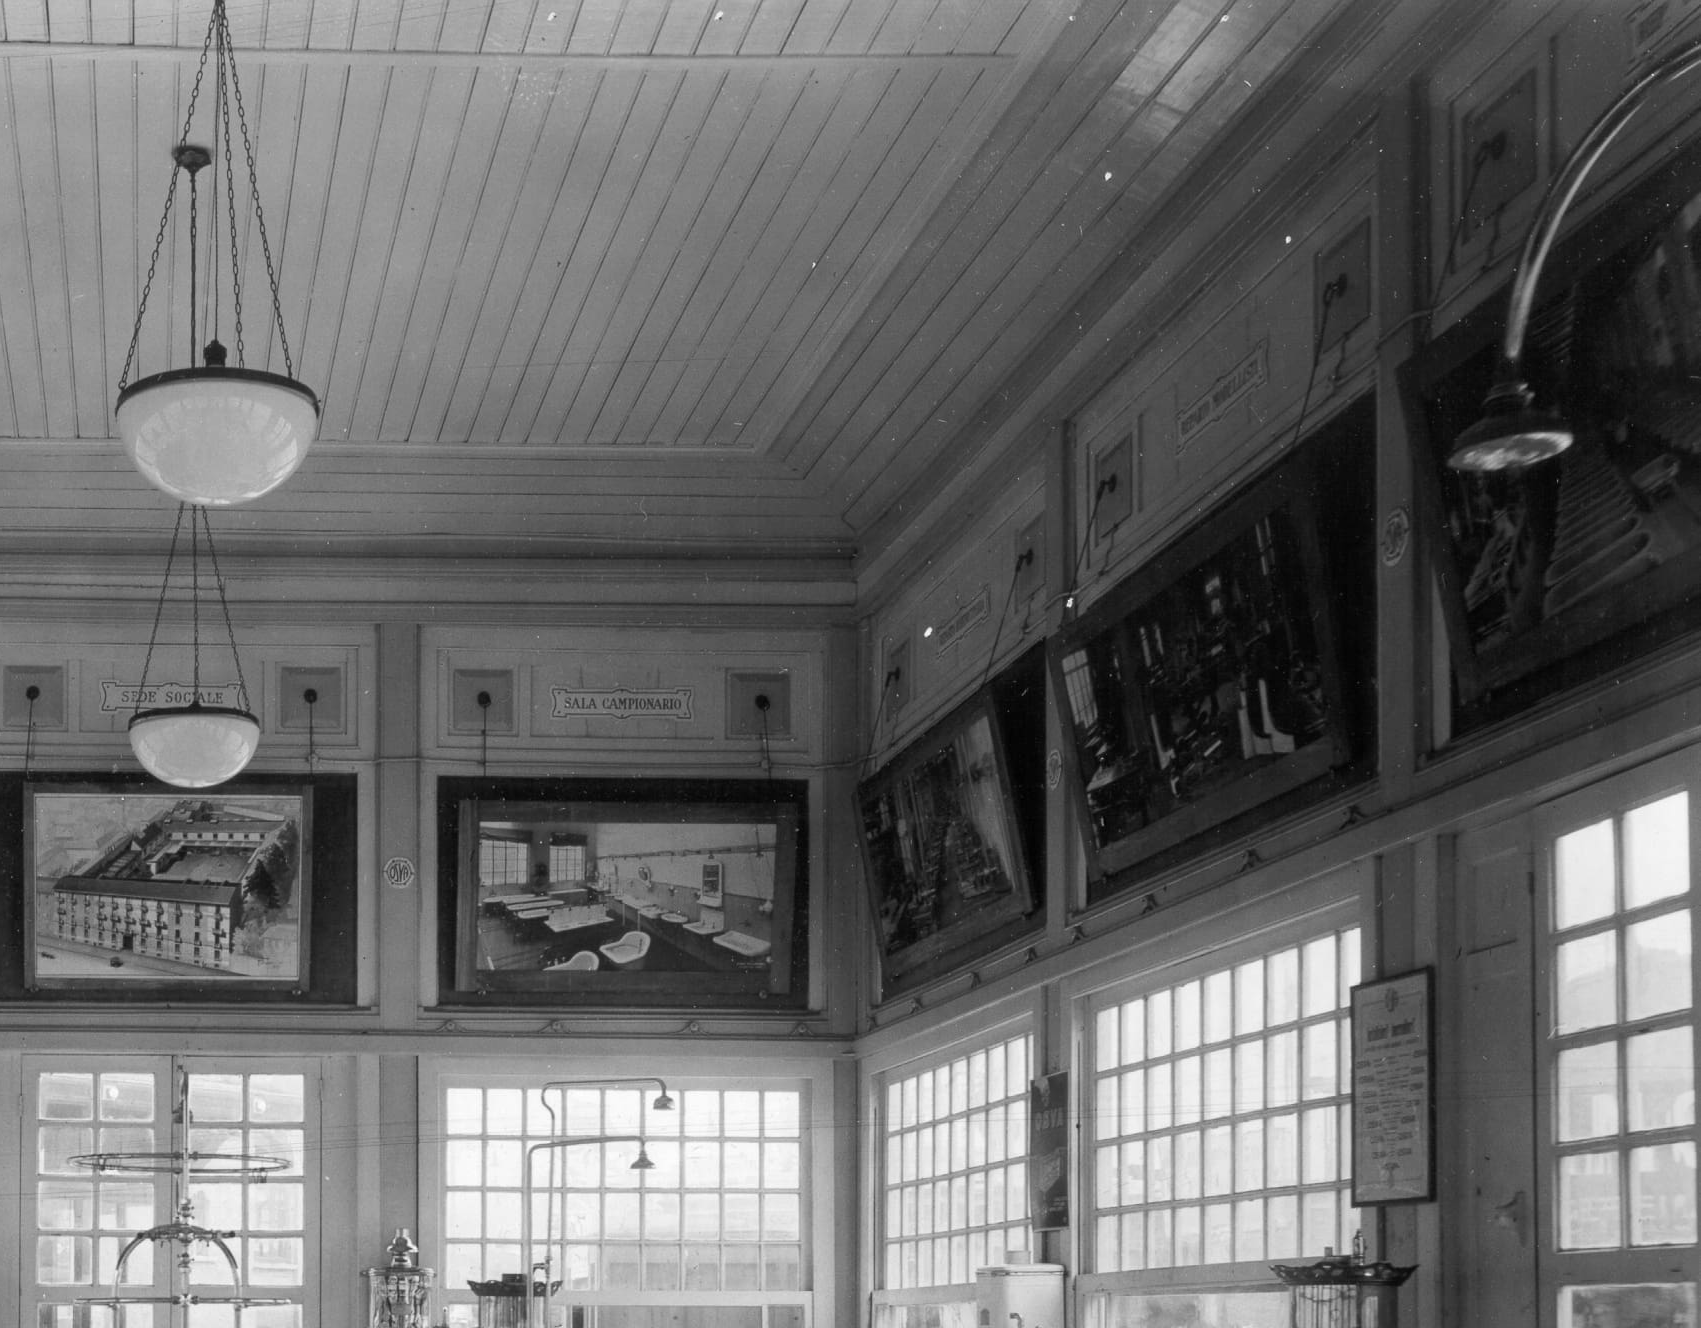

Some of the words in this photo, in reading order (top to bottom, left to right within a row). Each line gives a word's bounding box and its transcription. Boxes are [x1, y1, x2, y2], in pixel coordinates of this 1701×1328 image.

[120, 690, 157, 703] SEDE
[165, 691, 224, 704] SOCALE
[563, 697, 597, 710] SALA
[602, 697, 682, 711] CAMPIONARIO
